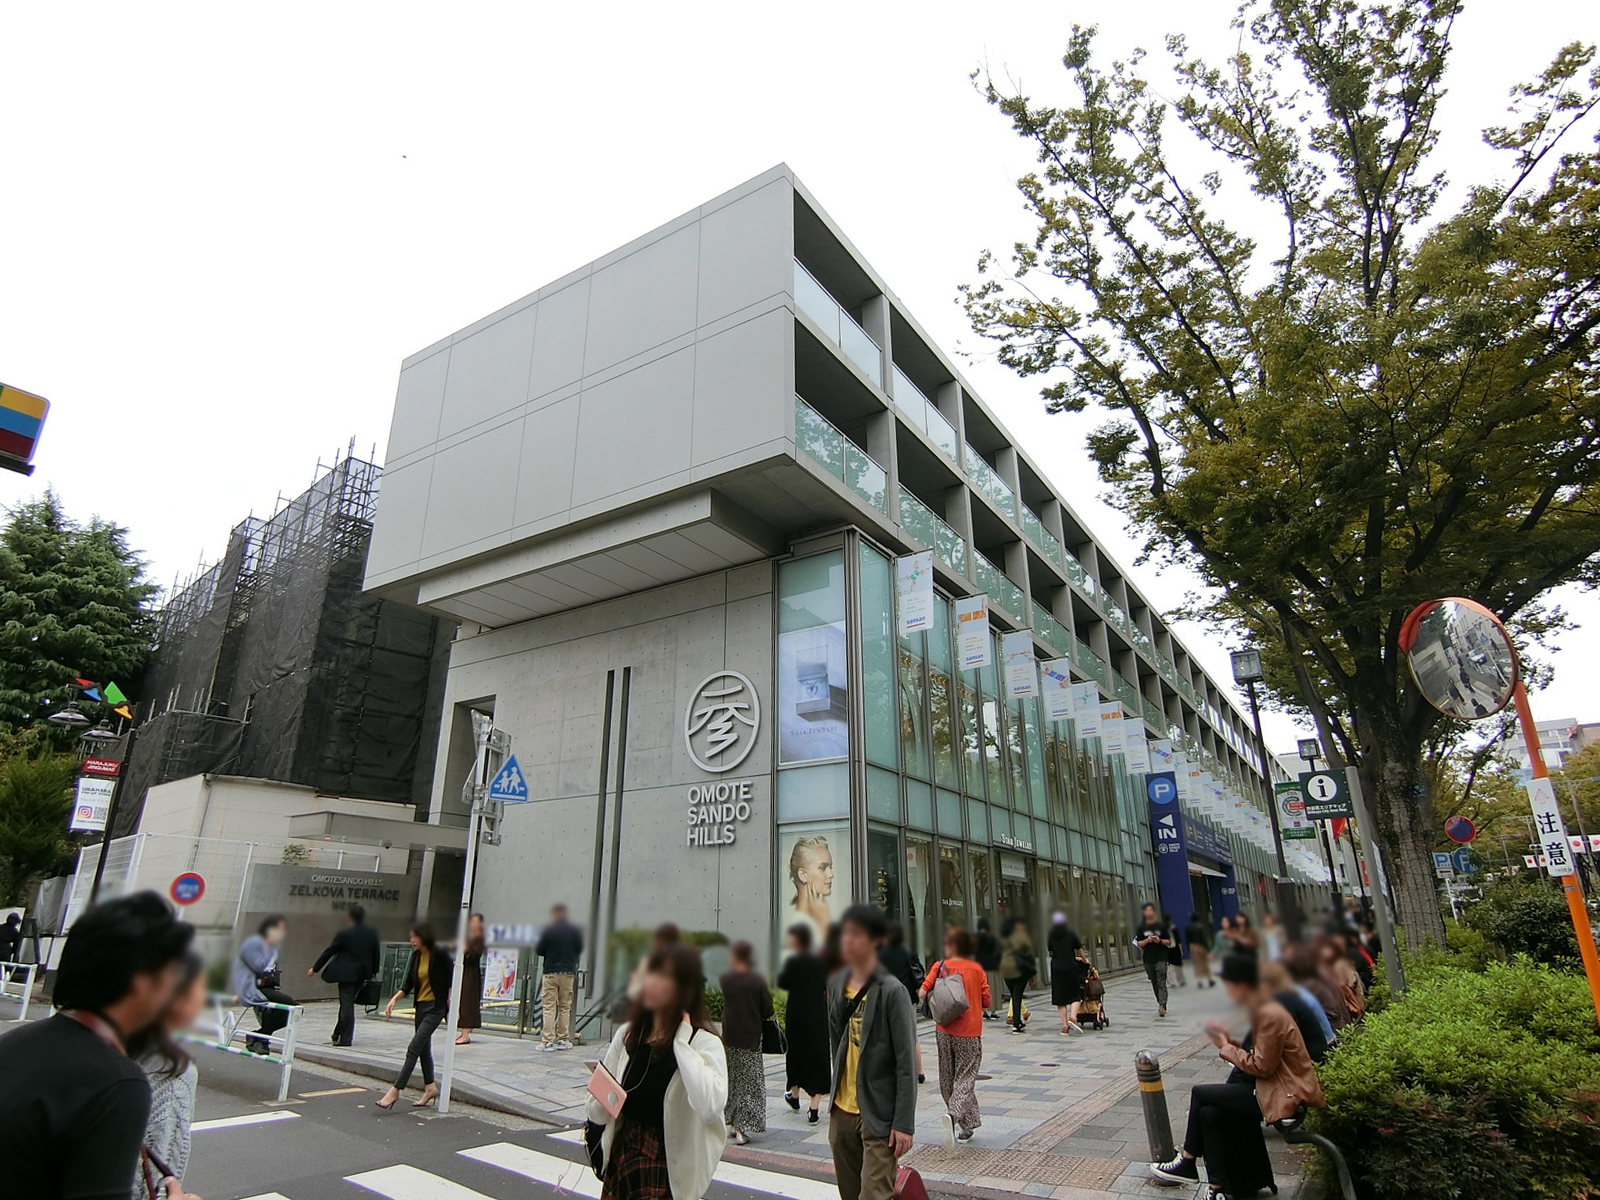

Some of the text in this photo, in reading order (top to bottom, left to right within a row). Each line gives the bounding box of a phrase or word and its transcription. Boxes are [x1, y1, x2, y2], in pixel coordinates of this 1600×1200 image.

[906, 616, 926, 625] sansan
[966, 654, 984, 662] sansan
[688, 781, 753, 805] OMOTE
[1154, 784, 1170, 799] P
[687, 801, 751, 825] SANDO
[687, 824, 736, 846] HILLS
[1157, 828, 1177, 840] IN
[1536, 811, 1567, 866] 注意
[1435, 854, 1448, 867] P
[312, 874, 363, 885] OMOTESANDO
[288, 885, 400, 901] ZELKOVA TERRACE
